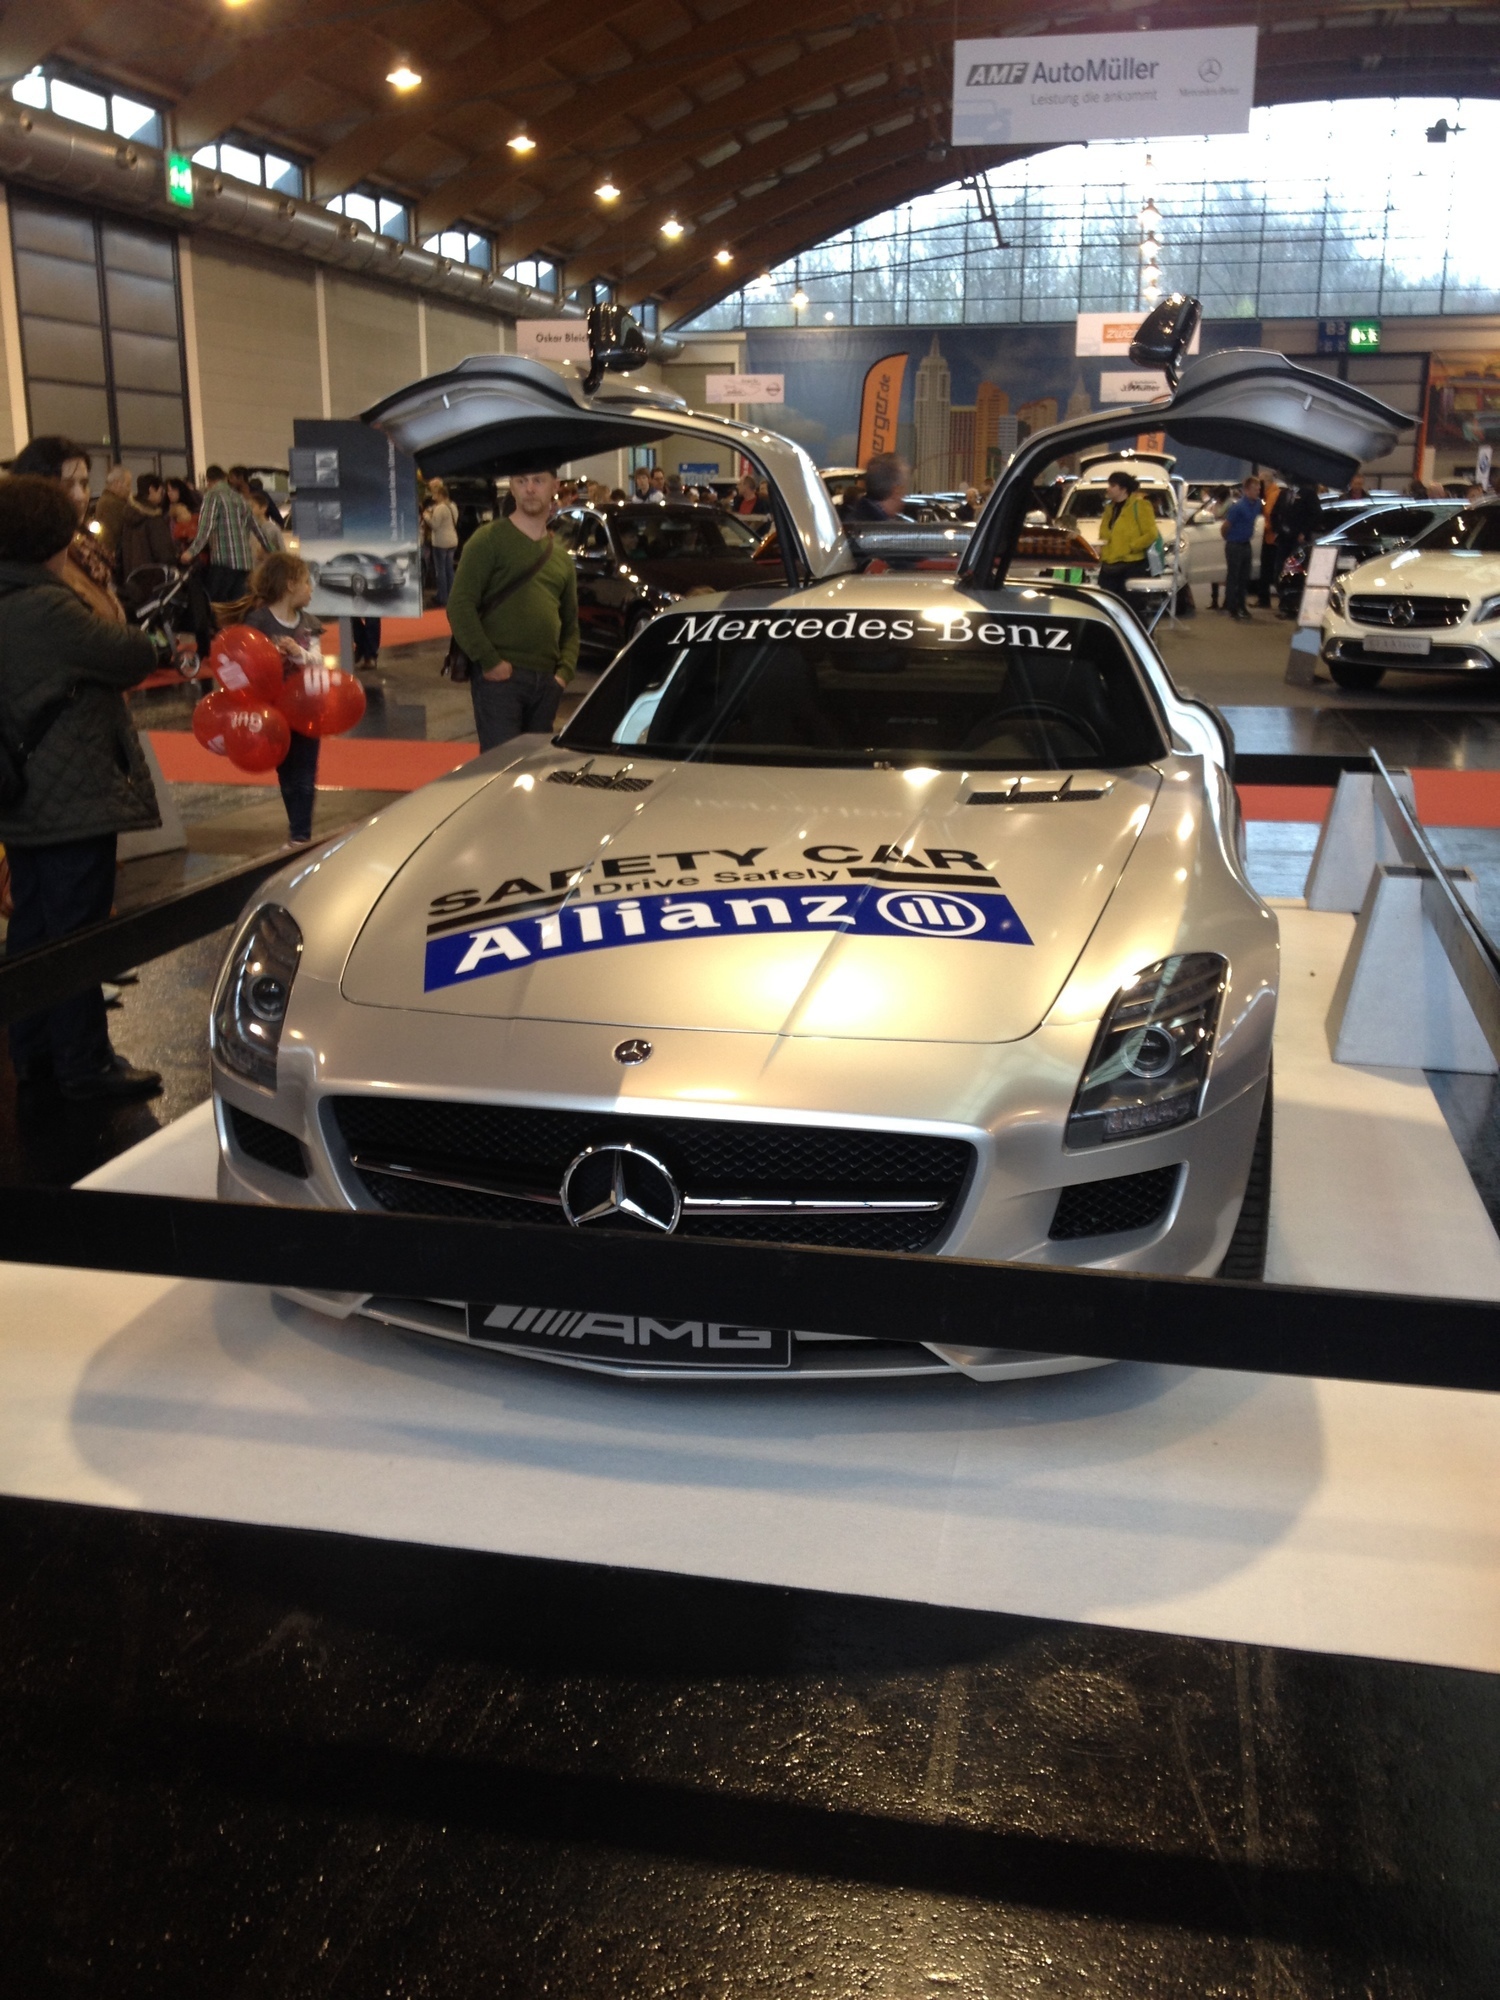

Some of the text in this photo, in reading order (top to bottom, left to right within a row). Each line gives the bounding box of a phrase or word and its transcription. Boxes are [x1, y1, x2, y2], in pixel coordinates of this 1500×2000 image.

[969, 57, 1160, 86] AMF AutoMüller
[536, 332, 562, 343] Oskar
[872, 374, 891, 456] erger.de
[667, 612, 1073, 651] Mercedes-Benz
[427, 844, 991, 918] SAFETY CAR
[591, 867, 840, 896] Drive Safely
[454, 894, 857, 975] Allianz
